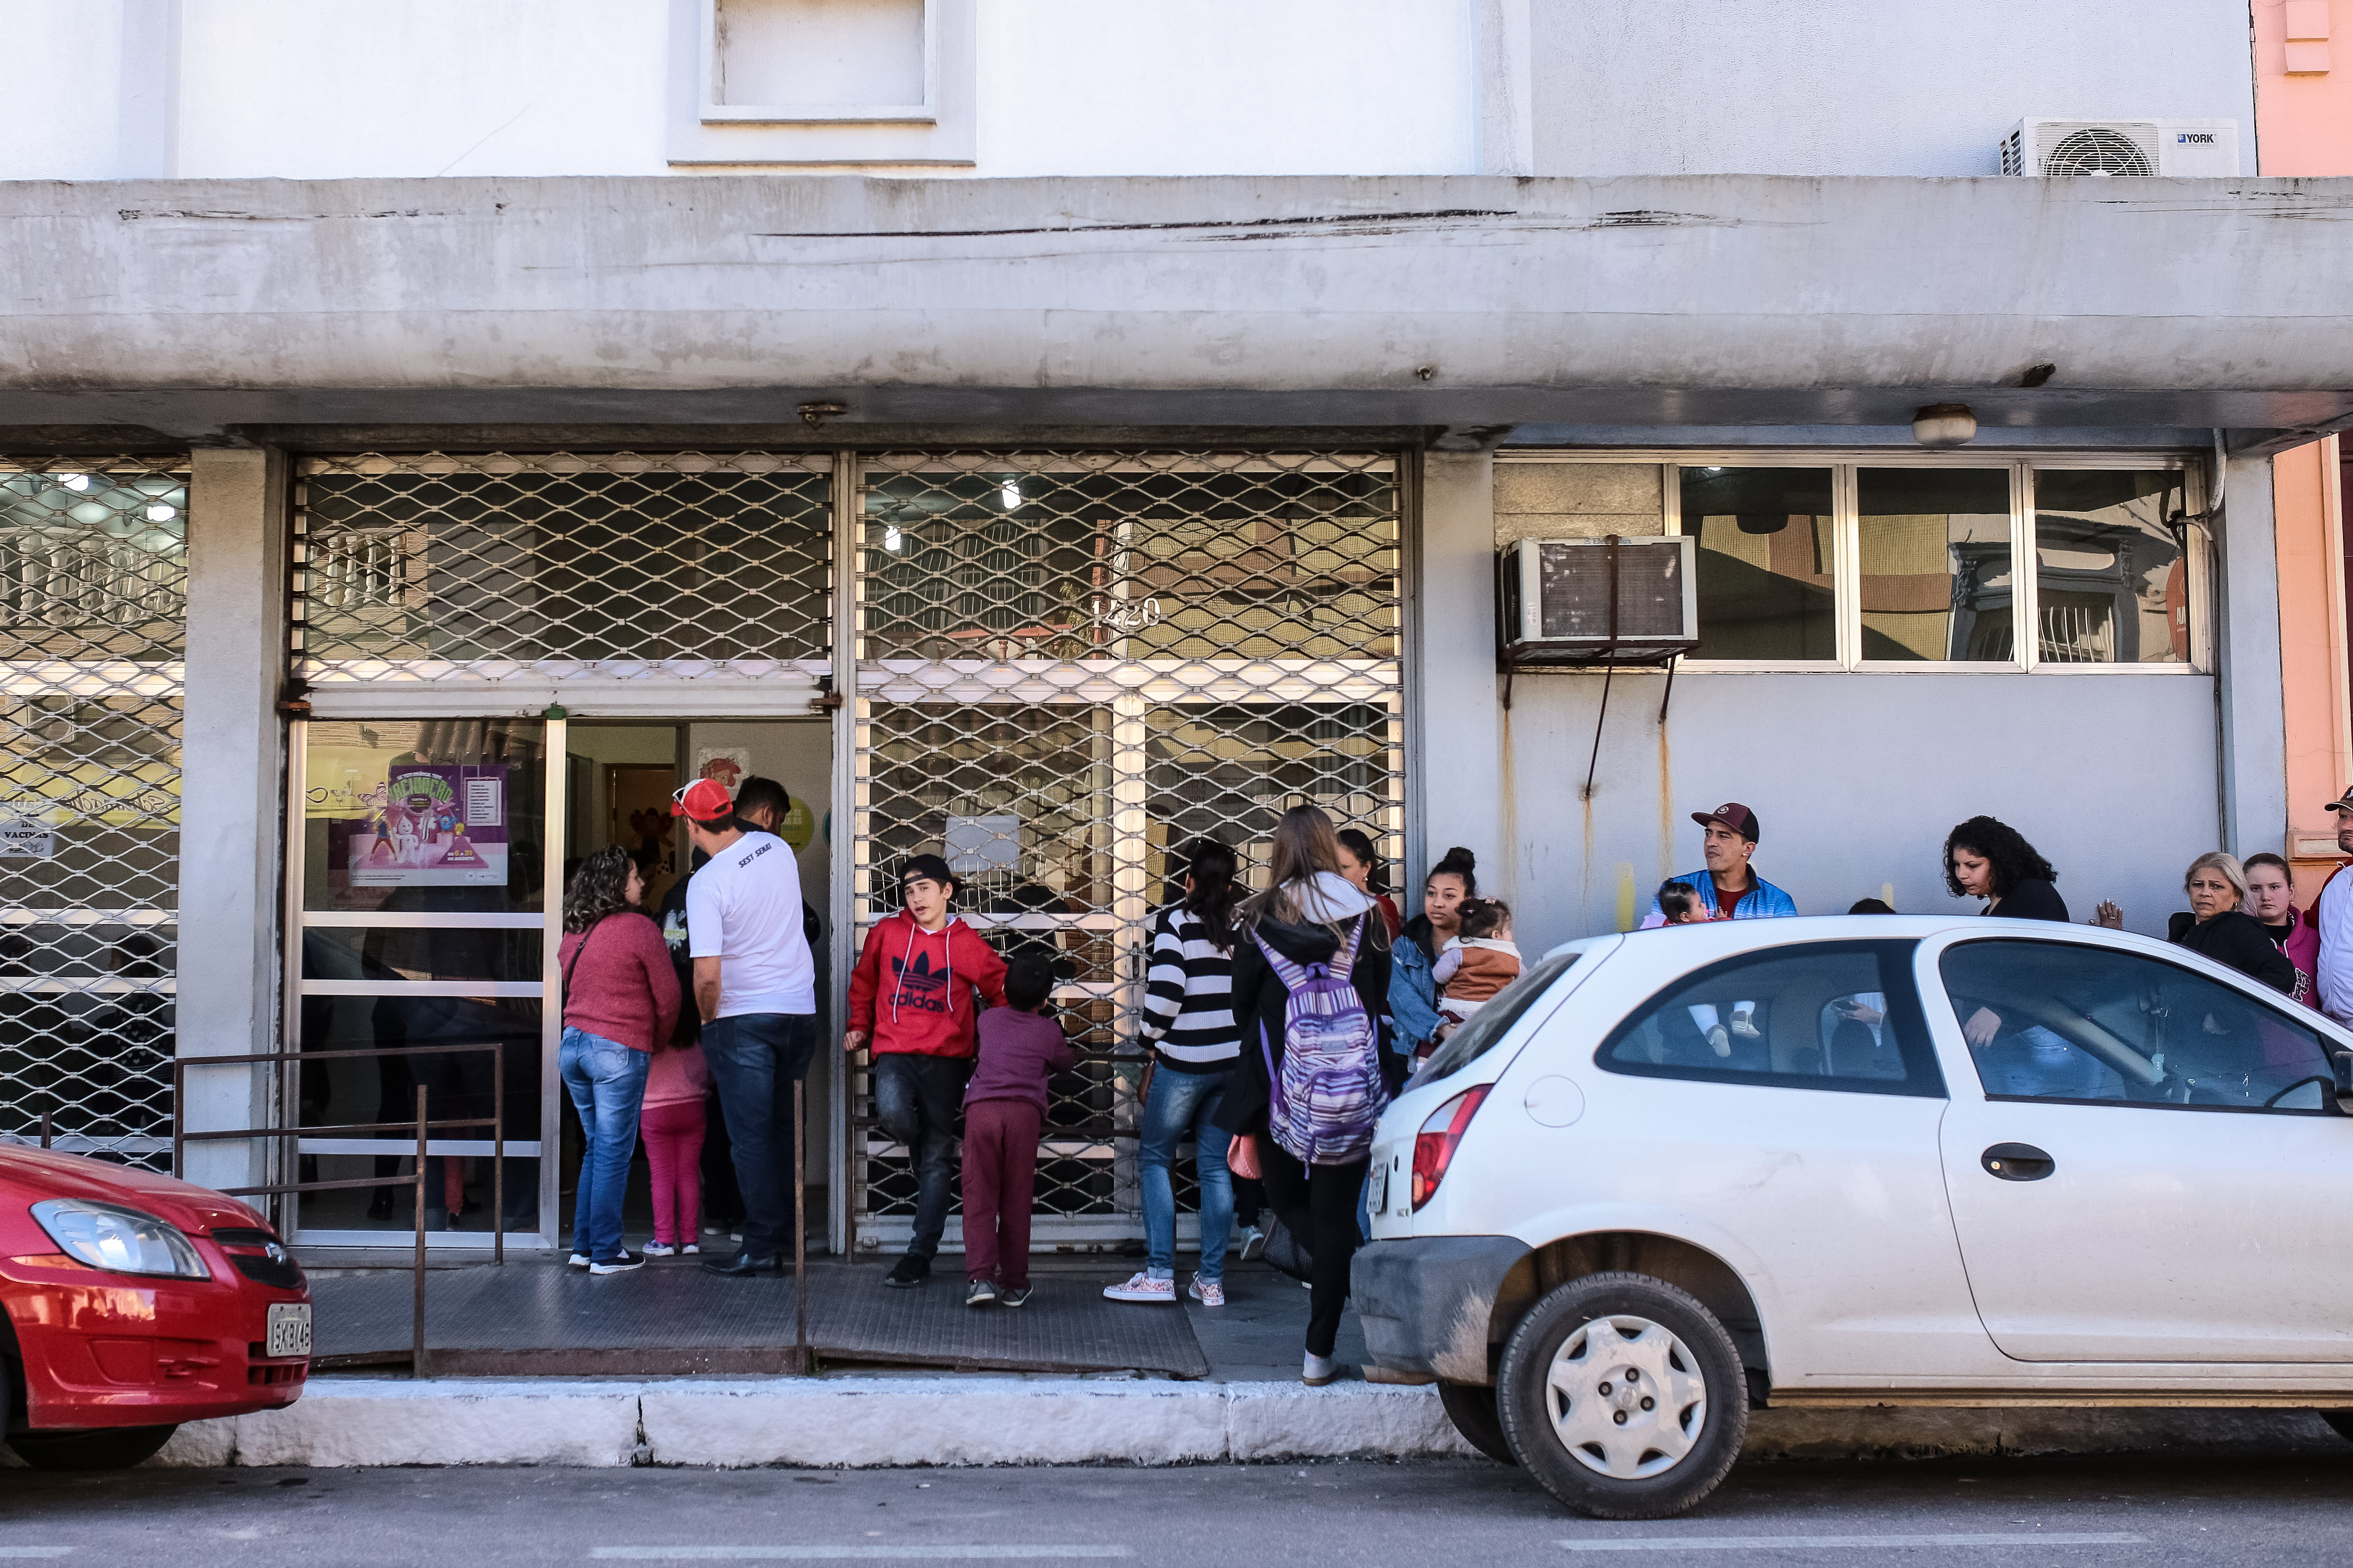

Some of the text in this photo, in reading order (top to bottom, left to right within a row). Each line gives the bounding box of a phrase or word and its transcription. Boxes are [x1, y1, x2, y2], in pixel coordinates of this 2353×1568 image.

[2186, 134, 2214, 143] YORK
[1091, 597, 1161, 628] 1420
[738, 853, 754, 868] SEST
[888, 991, 945, 1013] adidas
